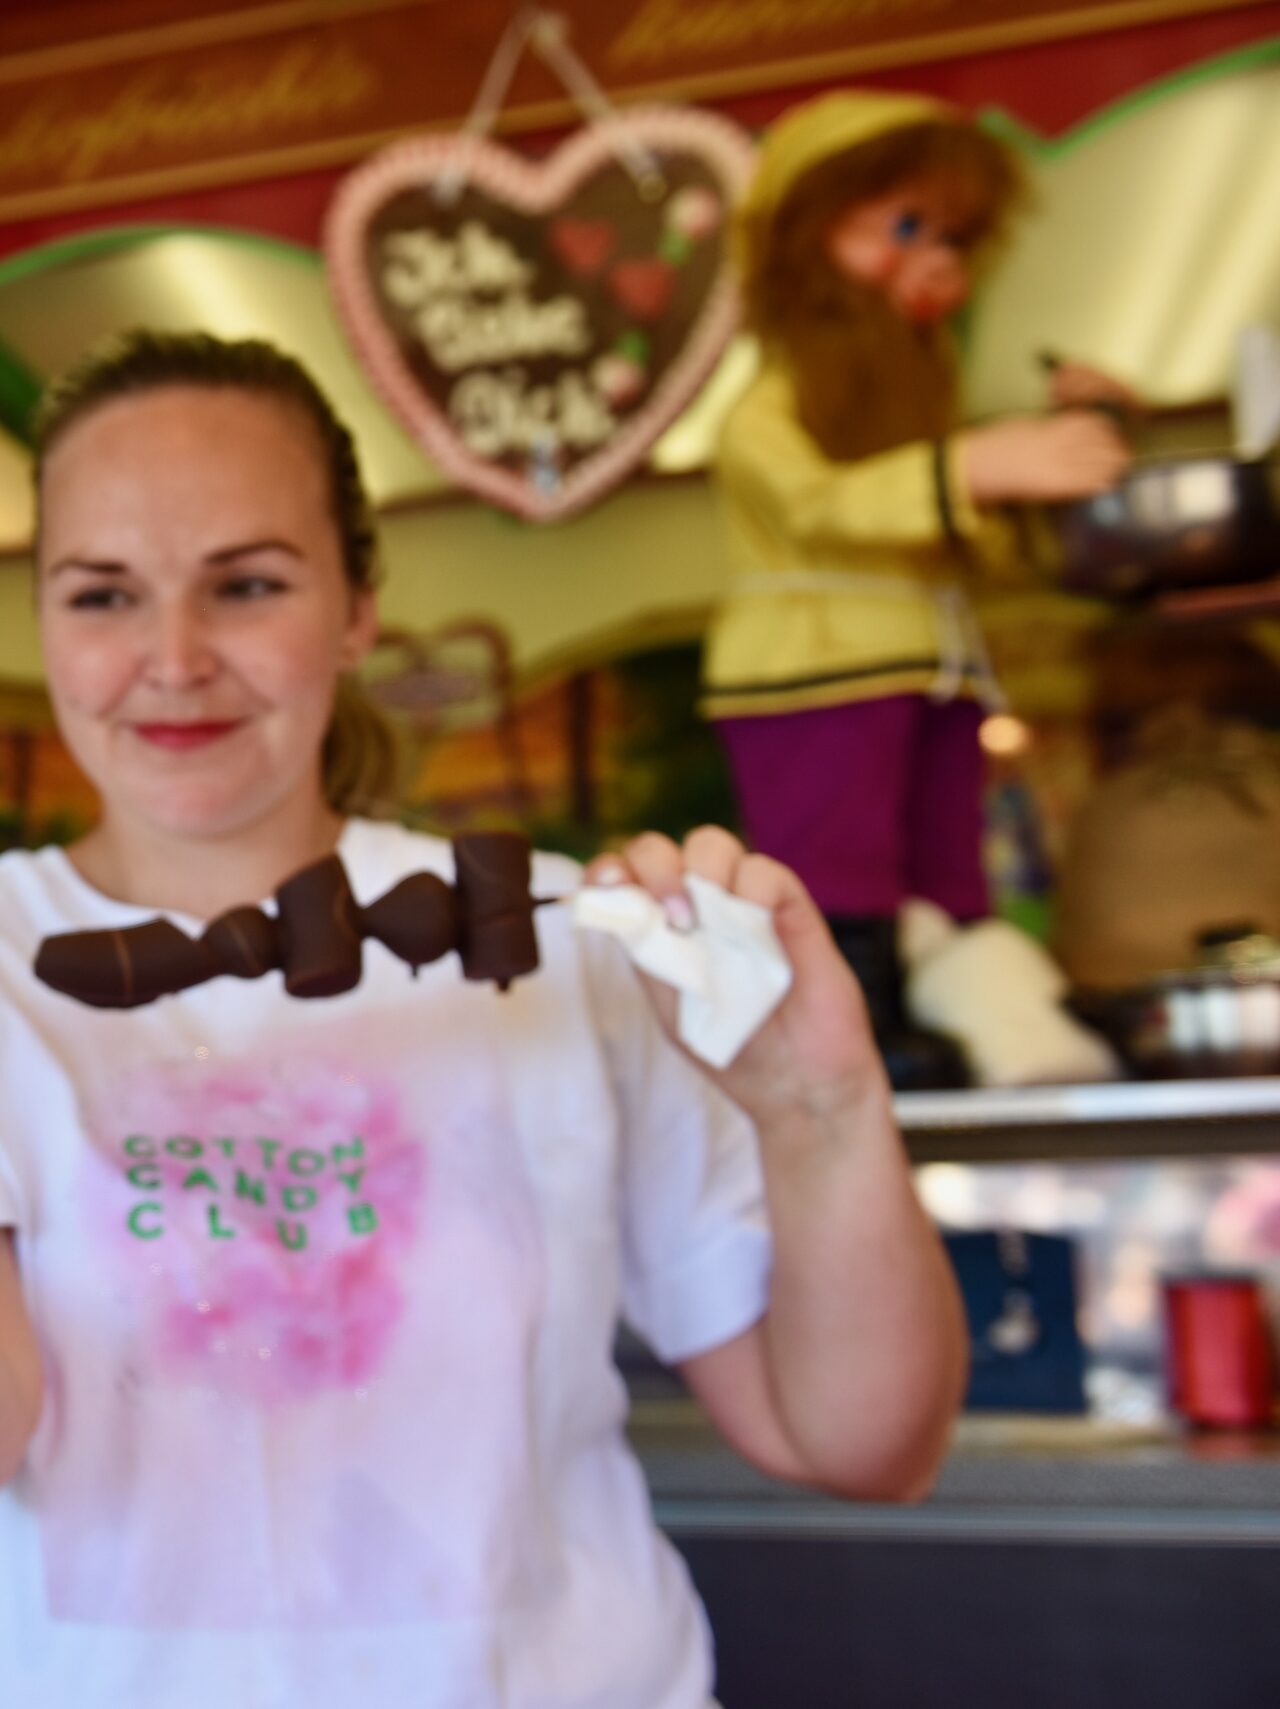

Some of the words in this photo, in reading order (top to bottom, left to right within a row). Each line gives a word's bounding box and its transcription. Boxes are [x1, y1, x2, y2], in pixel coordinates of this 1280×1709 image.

[123, 1135, 366, 1177] COTTON
[126, 1162, 366, 1214] CANDY
[126, 1200, 380, 1252] CLUB
